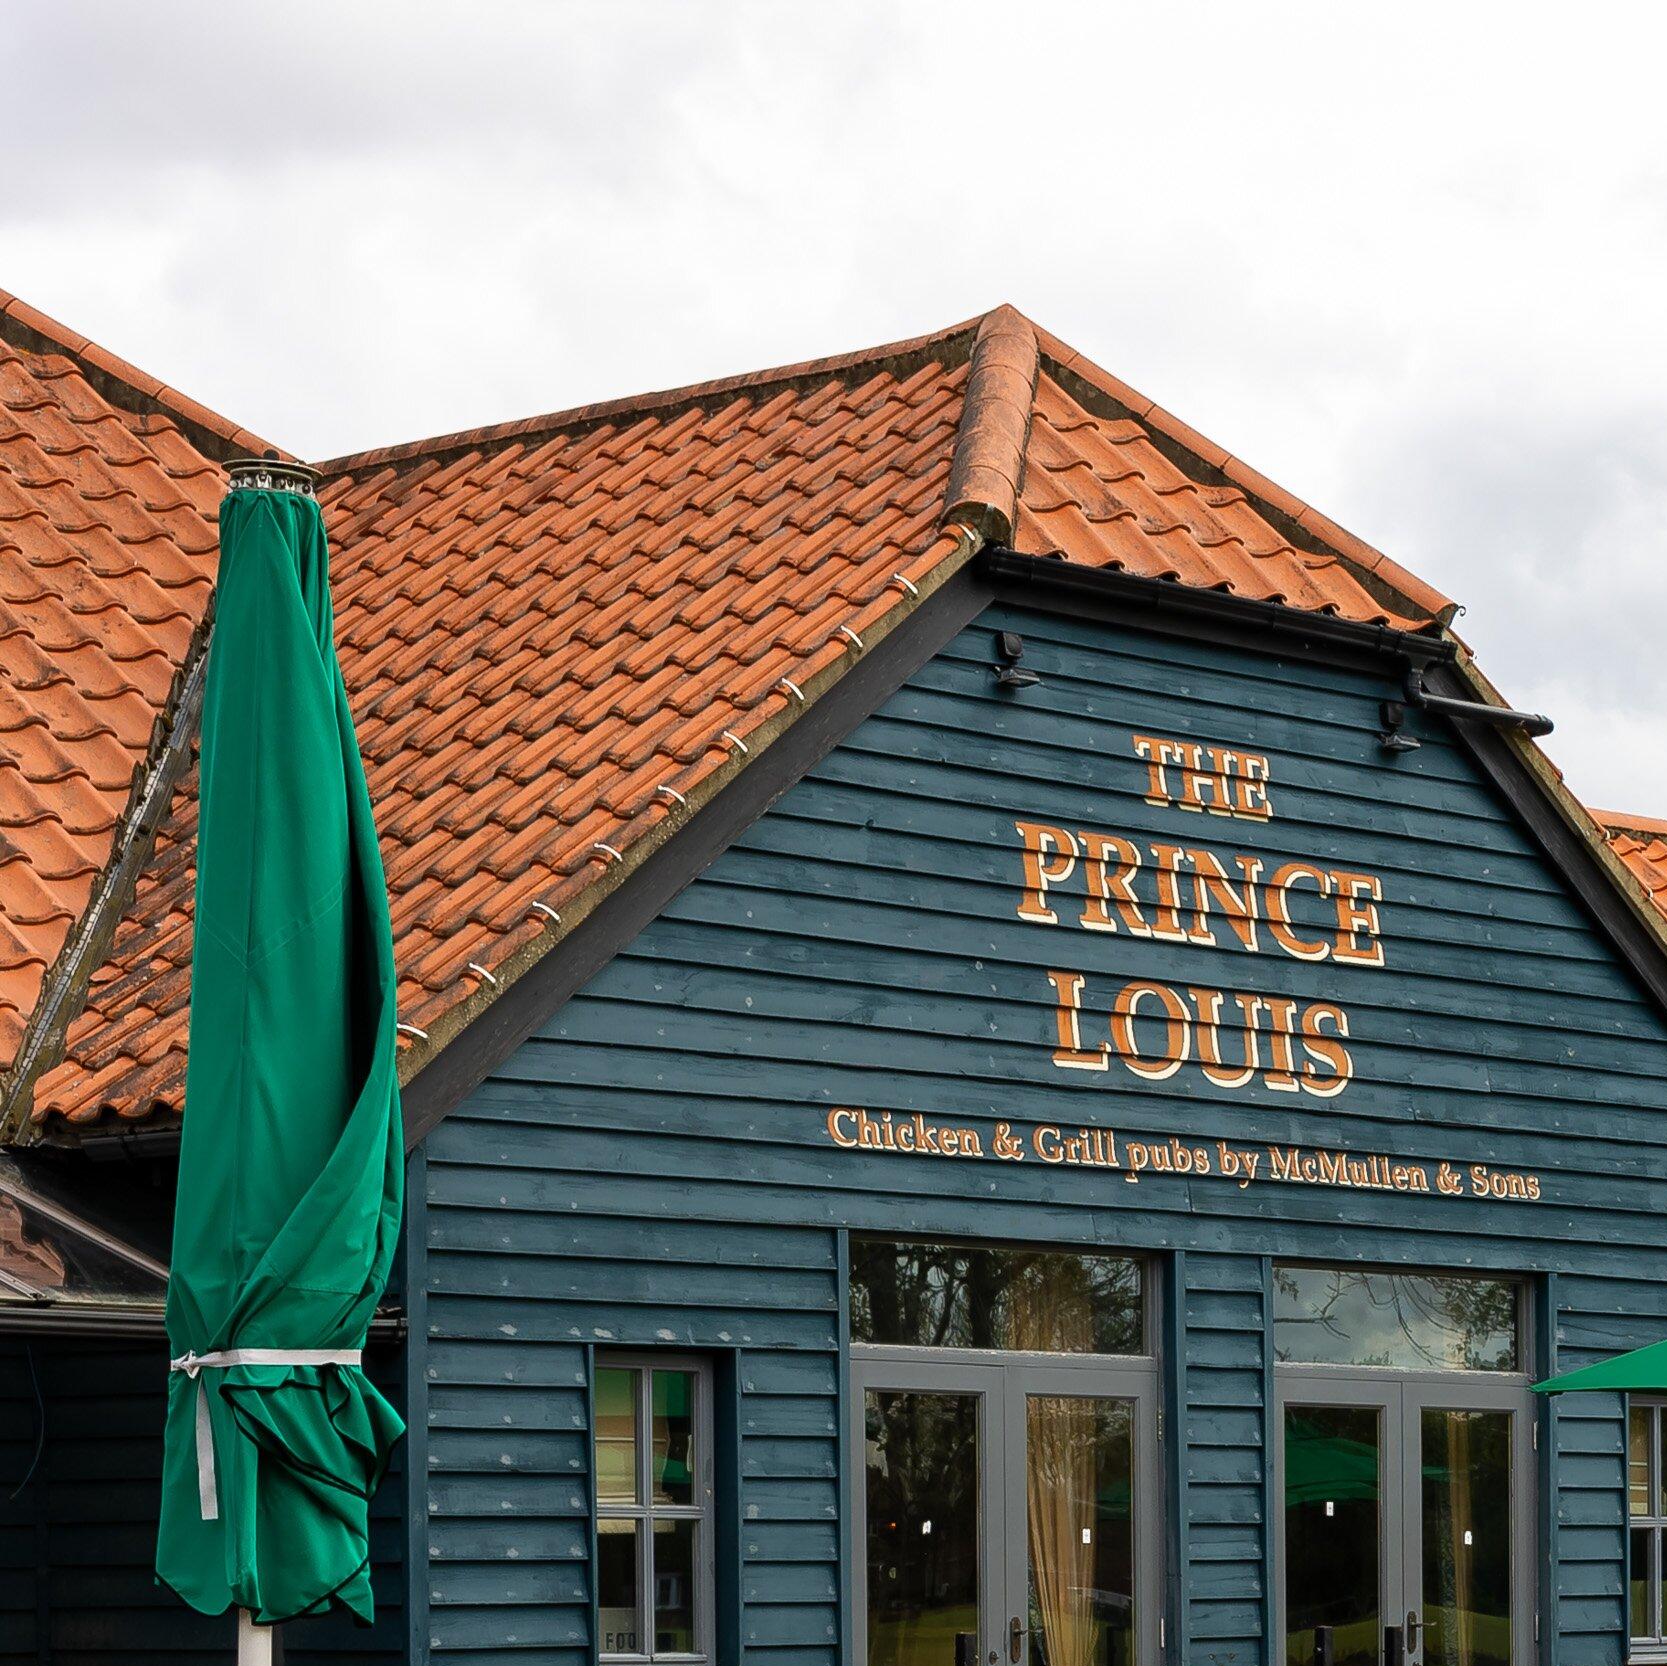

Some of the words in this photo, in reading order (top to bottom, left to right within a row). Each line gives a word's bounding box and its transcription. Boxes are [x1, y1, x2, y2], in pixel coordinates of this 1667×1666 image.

[1132, 734, 1273, 823] THE
[1014, 821, 1386, 967] PRINCE
[1046, 971, 1354, 1098] LOUIS
[826, 1107, 984, 1157] Chicken
[991, 1121, 1025, 1161] &
[1032, 1124, 1120, 1167] Grill
[1125, 1137, 1210, 1184] pubs
[1216, 1140, 1260, 1189] by
[1268, 1145, 1430, 1193] McMullen
[1436, 1160, 1464, 1196] &
[1471, 1163, 1542, 1201] Sons
